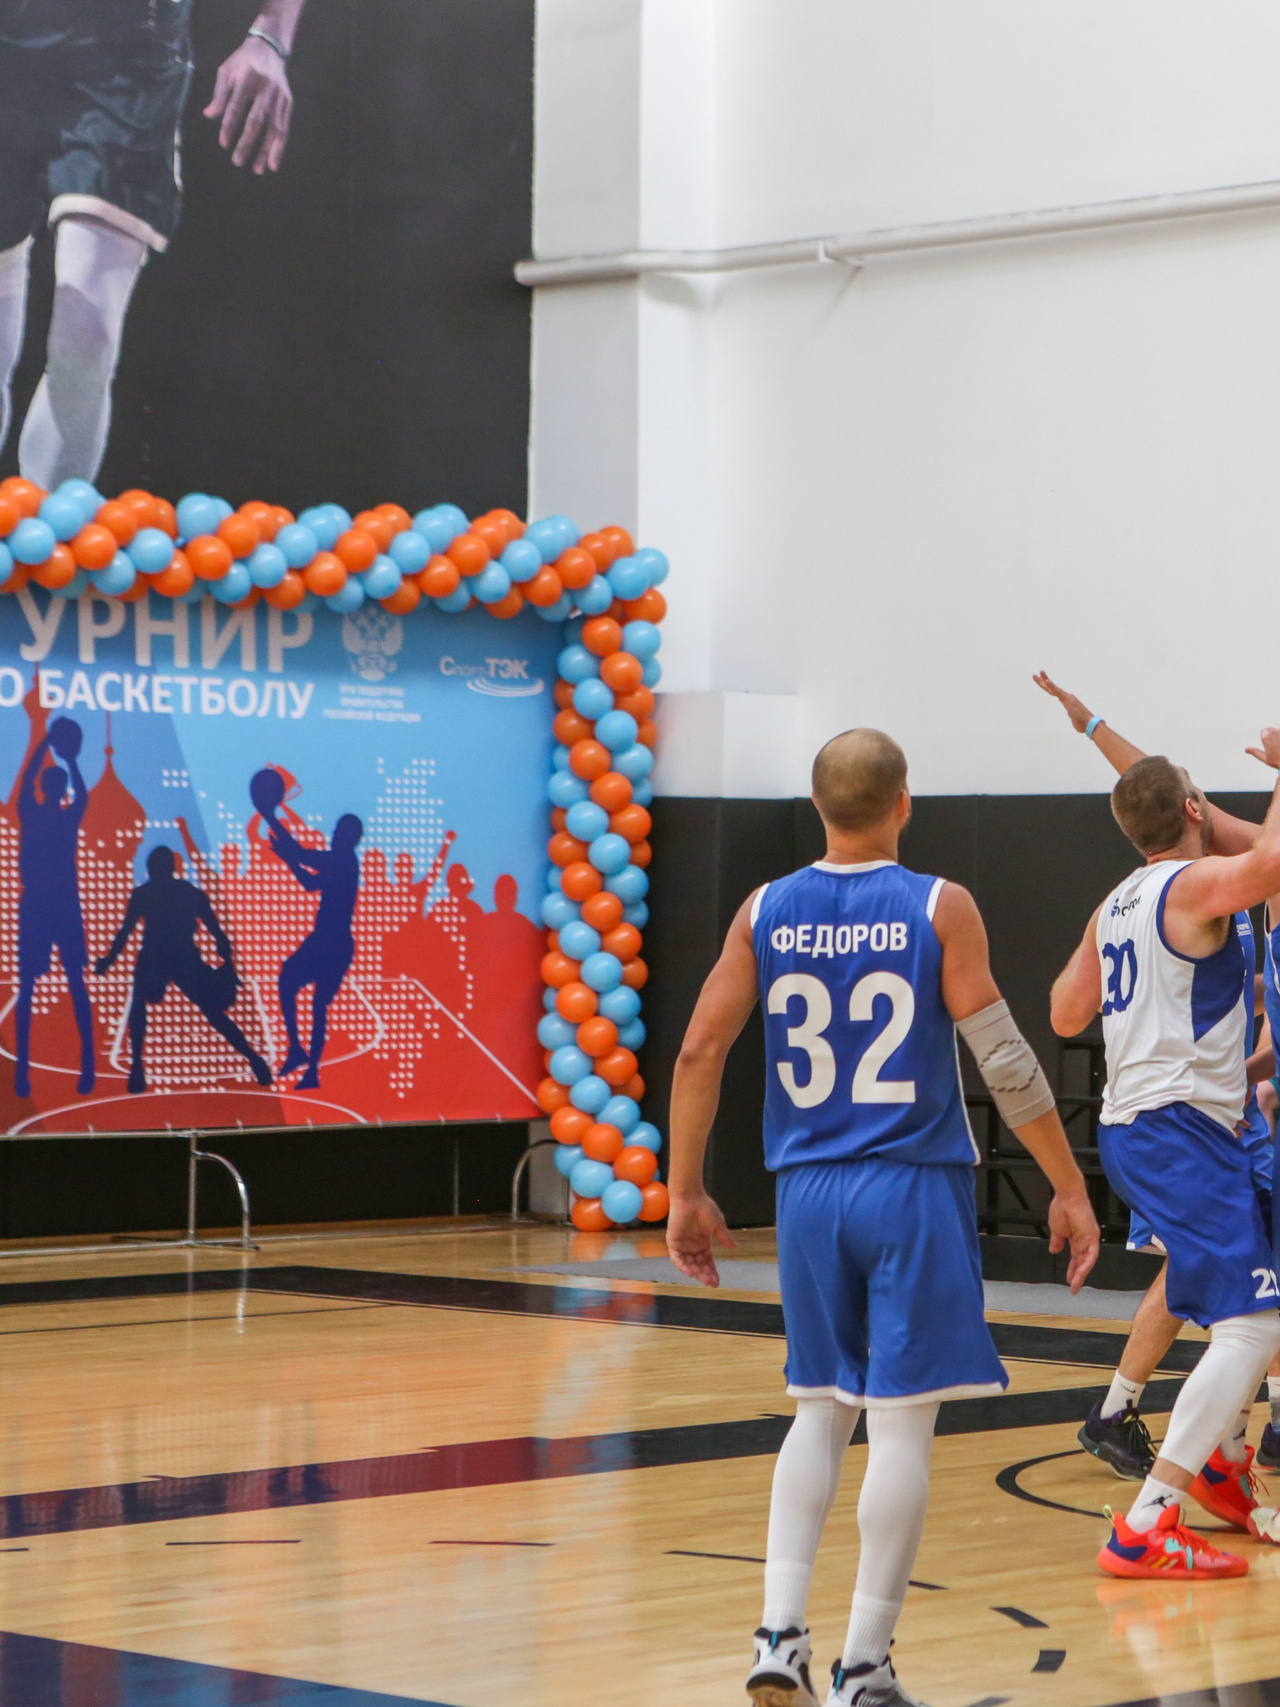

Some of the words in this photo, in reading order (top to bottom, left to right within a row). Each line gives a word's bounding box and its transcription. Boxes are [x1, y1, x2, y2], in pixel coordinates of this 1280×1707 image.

[39, 669, 316, 719] БАСКЕТБОЛУ
[771, 922, 908, 958] ФЕДОРОВ
[767, 971, 916, 1109] 32
